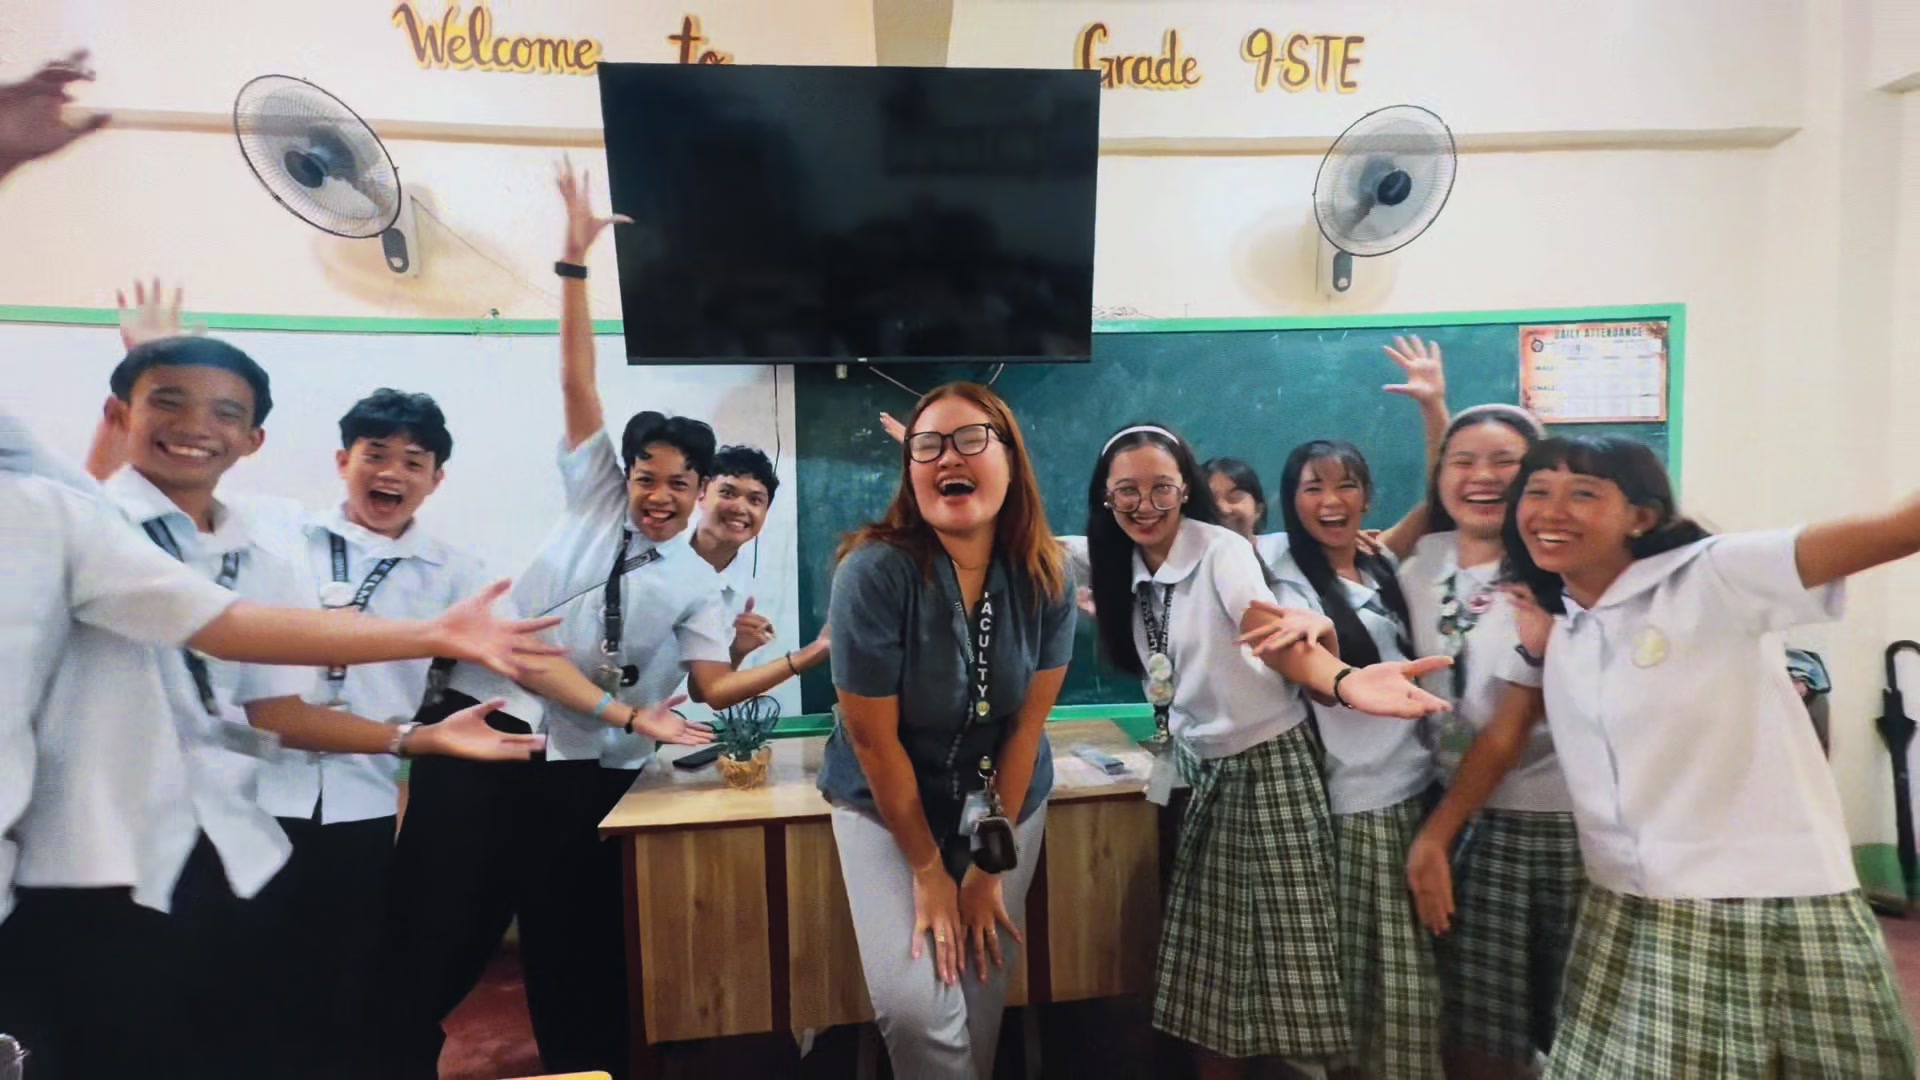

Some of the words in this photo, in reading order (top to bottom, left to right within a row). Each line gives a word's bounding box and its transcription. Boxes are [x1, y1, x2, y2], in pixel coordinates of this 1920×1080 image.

[391, 2, 600, 71] Welcome
[1081, 22, 1200, 88] Grade
[1246, 27, 1365, 88] 9-STE
